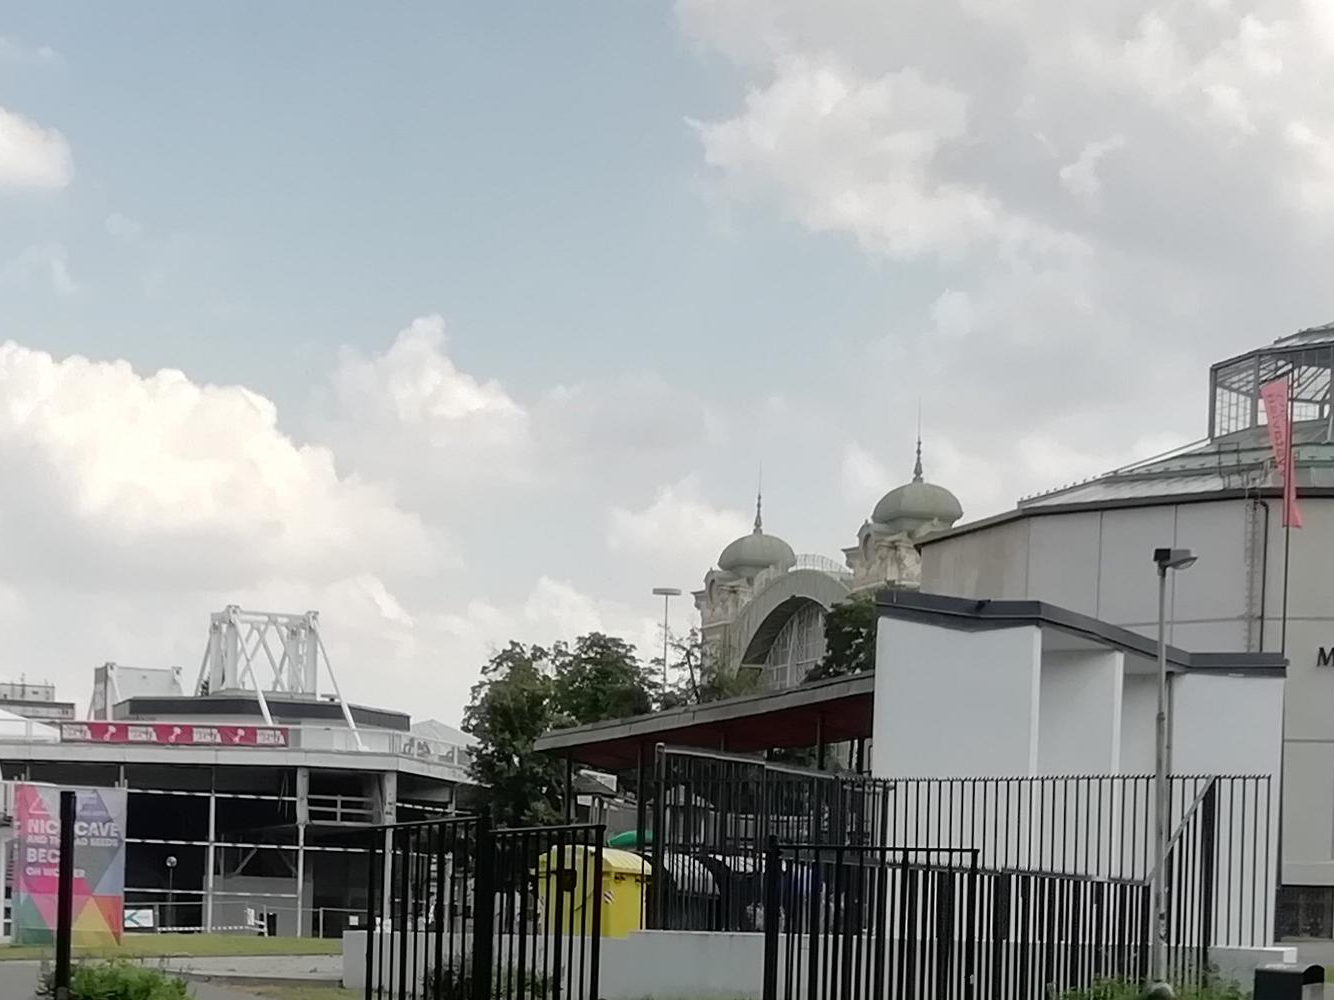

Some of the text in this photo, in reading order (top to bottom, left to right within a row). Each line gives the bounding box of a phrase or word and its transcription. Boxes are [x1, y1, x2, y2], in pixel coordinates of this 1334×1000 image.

[26, 818, 120, 838] NIC CAVE
[26, 847, 61, 865] BEC
